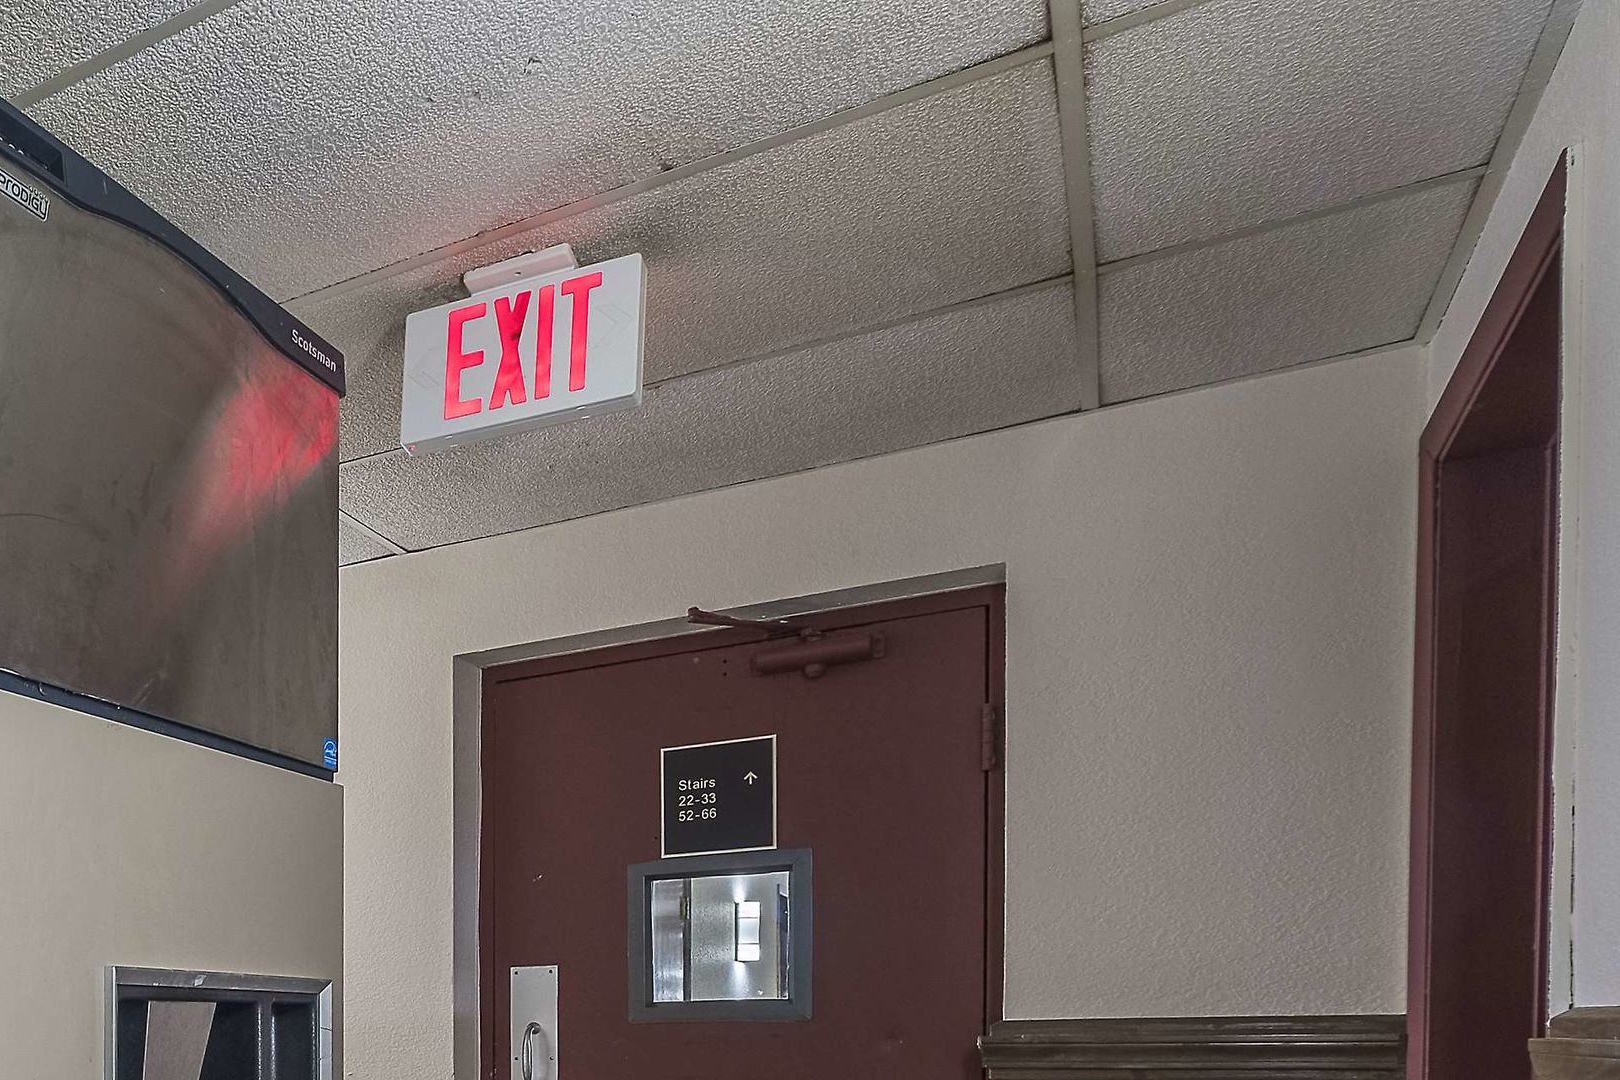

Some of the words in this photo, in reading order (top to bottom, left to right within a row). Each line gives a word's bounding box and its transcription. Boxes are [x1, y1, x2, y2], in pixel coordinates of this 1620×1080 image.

[291, 329, 337, 372] Scotsman
[443, 271, 604, 421] EXIT
[678, 778, 716, 791] Stairs
[678, 792, 717, 807] 22-33
[678, 807, 717, 822] 52-66
